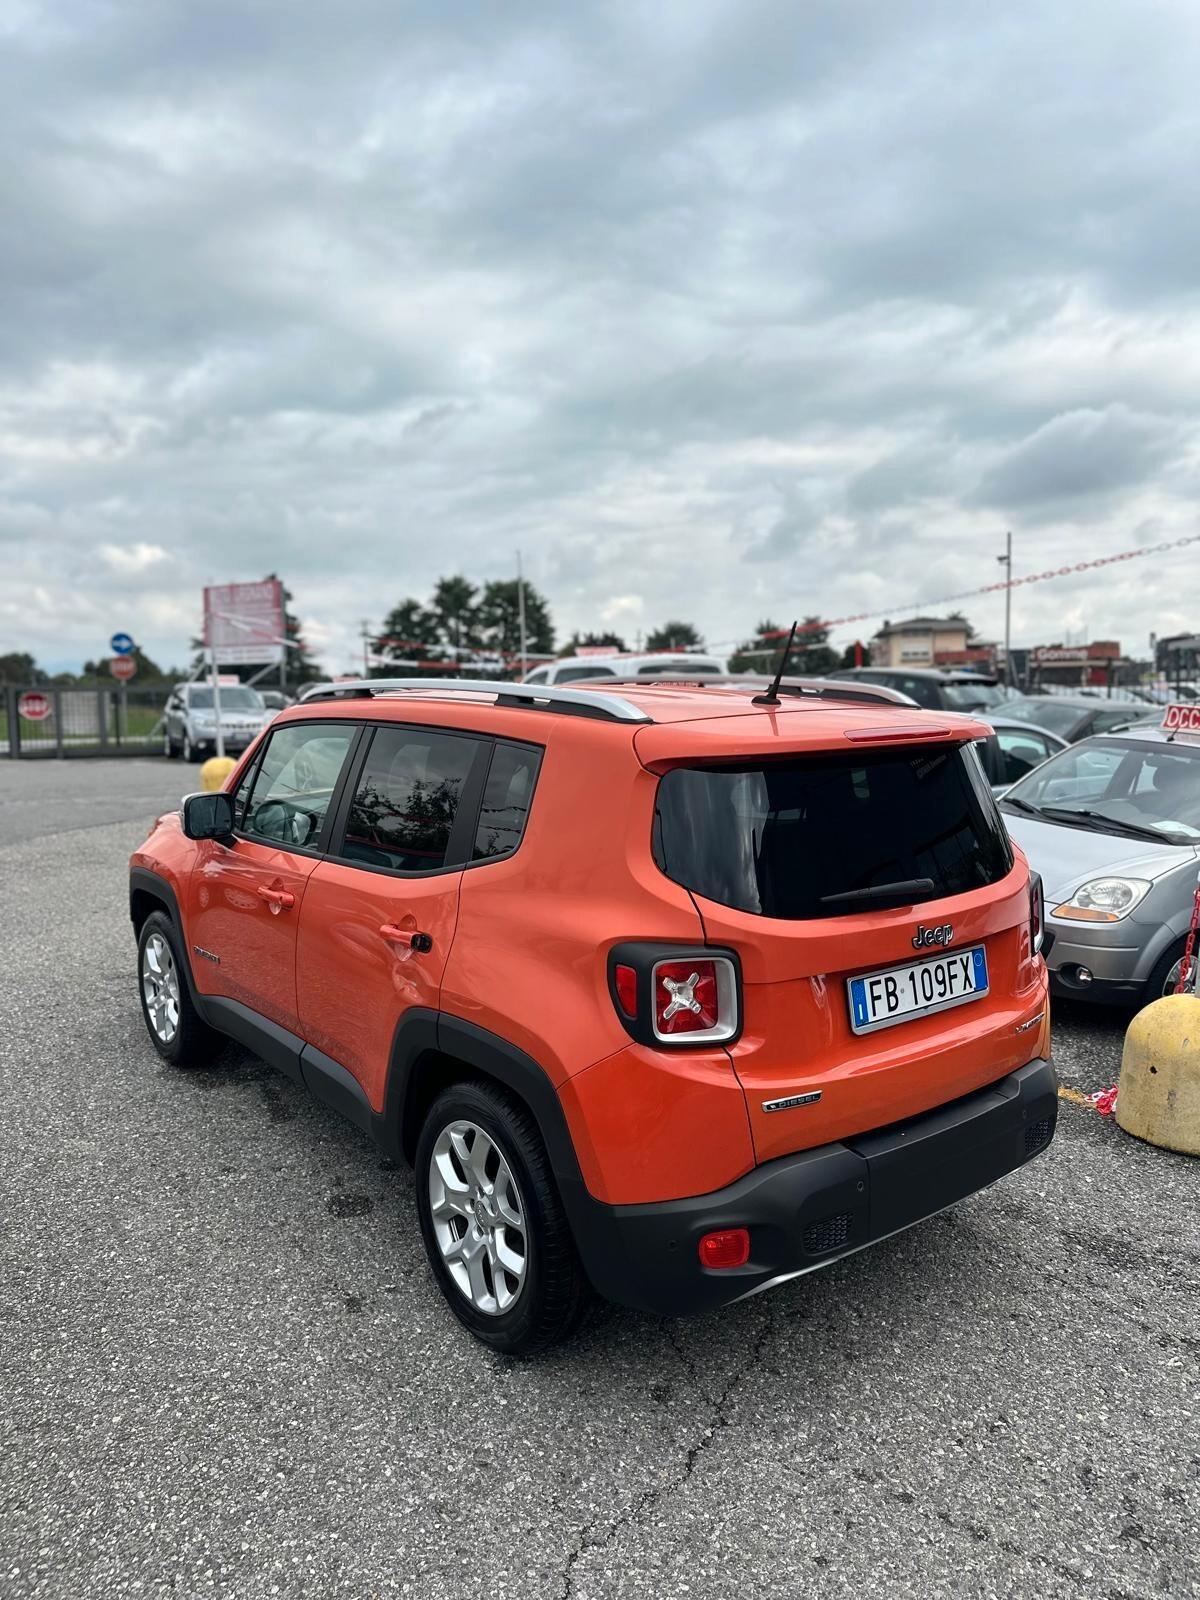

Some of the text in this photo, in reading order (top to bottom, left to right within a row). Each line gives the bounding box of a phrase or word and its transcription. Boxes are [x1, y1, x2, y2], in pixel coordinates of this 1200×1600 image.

[912, 924, 954, 949] Jeep
[869, 955, 973, 1017] FB 109FX
[779, 1094, 819, 1108] DIESEL
